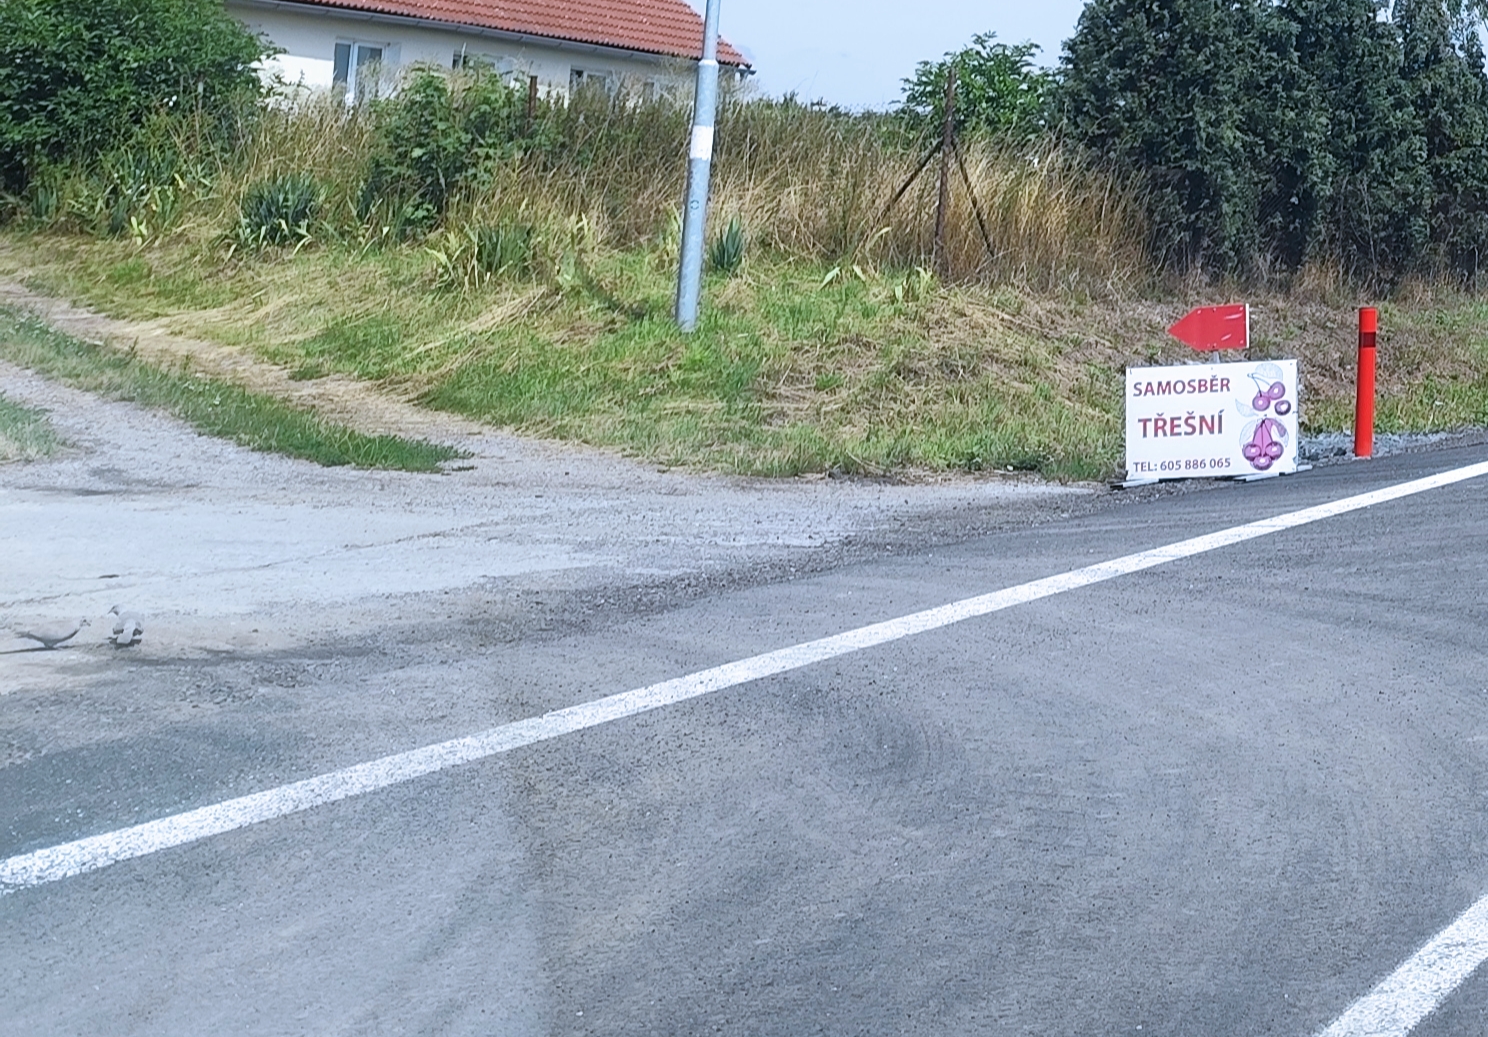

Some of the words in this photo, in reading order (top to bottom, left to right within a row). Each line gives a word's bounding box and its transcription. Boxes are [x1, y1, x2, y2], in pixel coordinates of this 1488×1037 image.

[1133, 375, 1231, 397] SAMOSBĚR
[1138, 409, 1225, 438] TŘEŠNÍ
[1133, 461, 1158, 473] TEL:
[1160, 460, 1183, 471] 605
[1184, 459, 1207, 470] 886
[1209, 457, 1231, 469] 065
